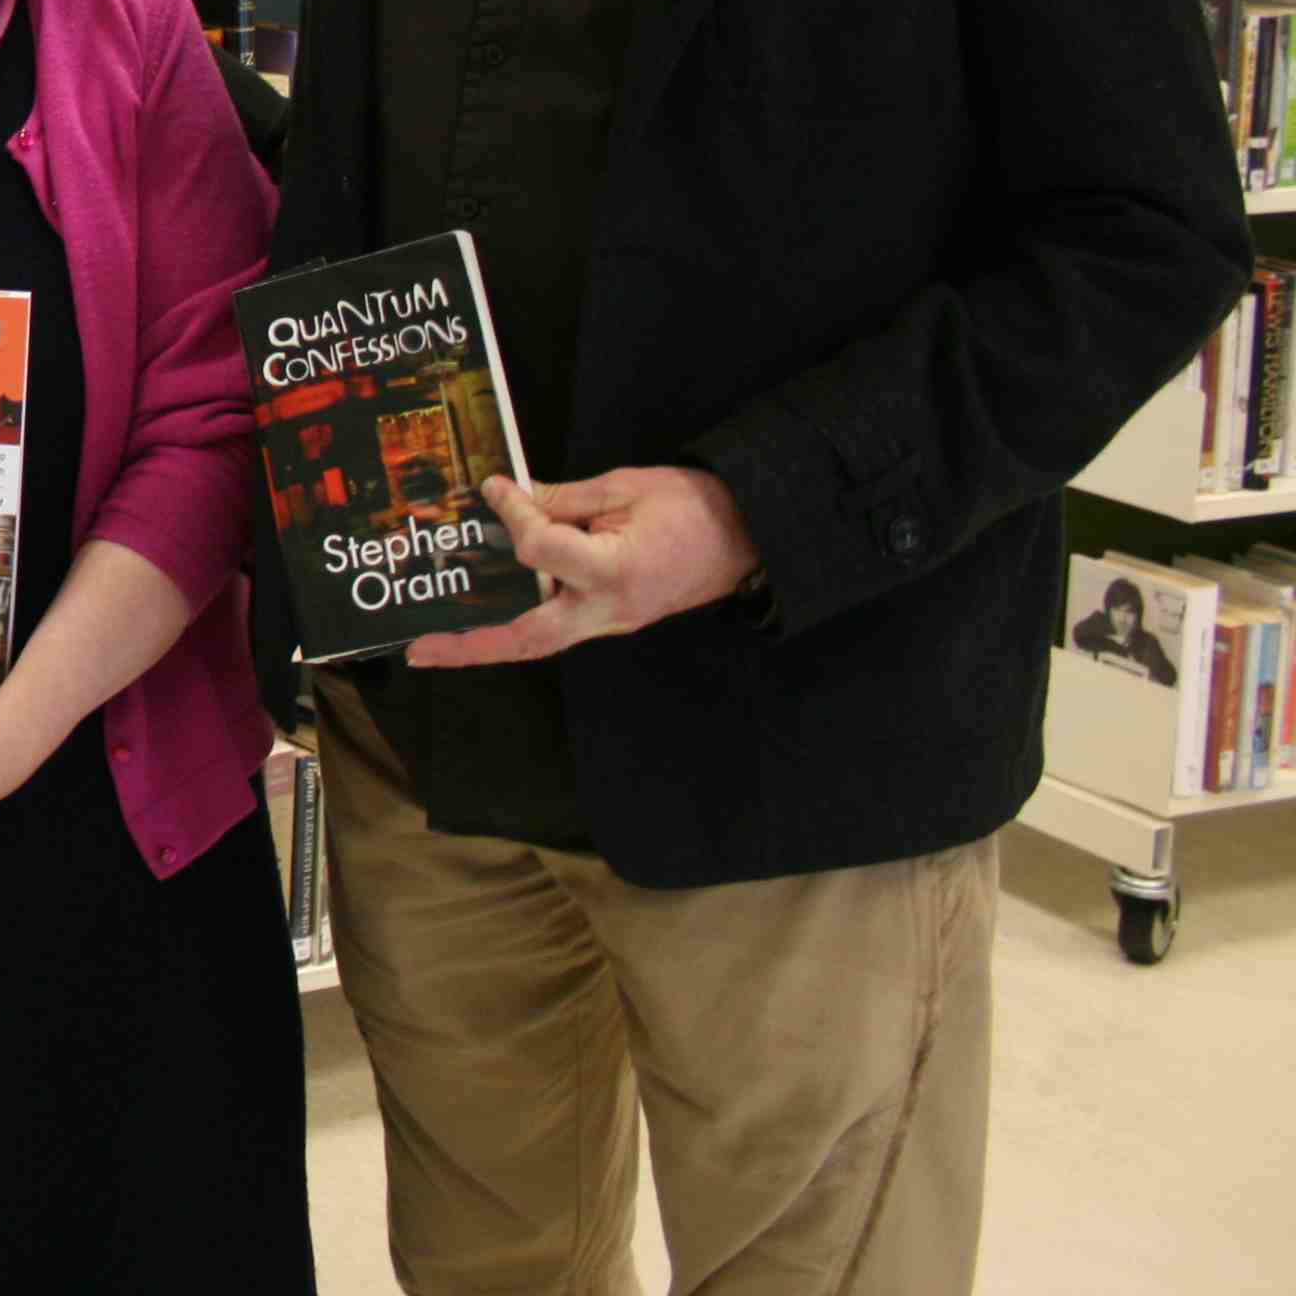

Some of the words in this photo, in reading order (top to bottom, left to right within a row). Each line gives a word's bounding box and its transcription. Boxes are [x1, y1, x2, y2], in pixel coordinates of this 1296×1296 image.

[267, 277, 449, 347] QUANTUM
[262, 314, 468, 388] CONFESSIONS
[323, 515, 486, 575] Stephen
[351, 566, 471, 612] Oram
